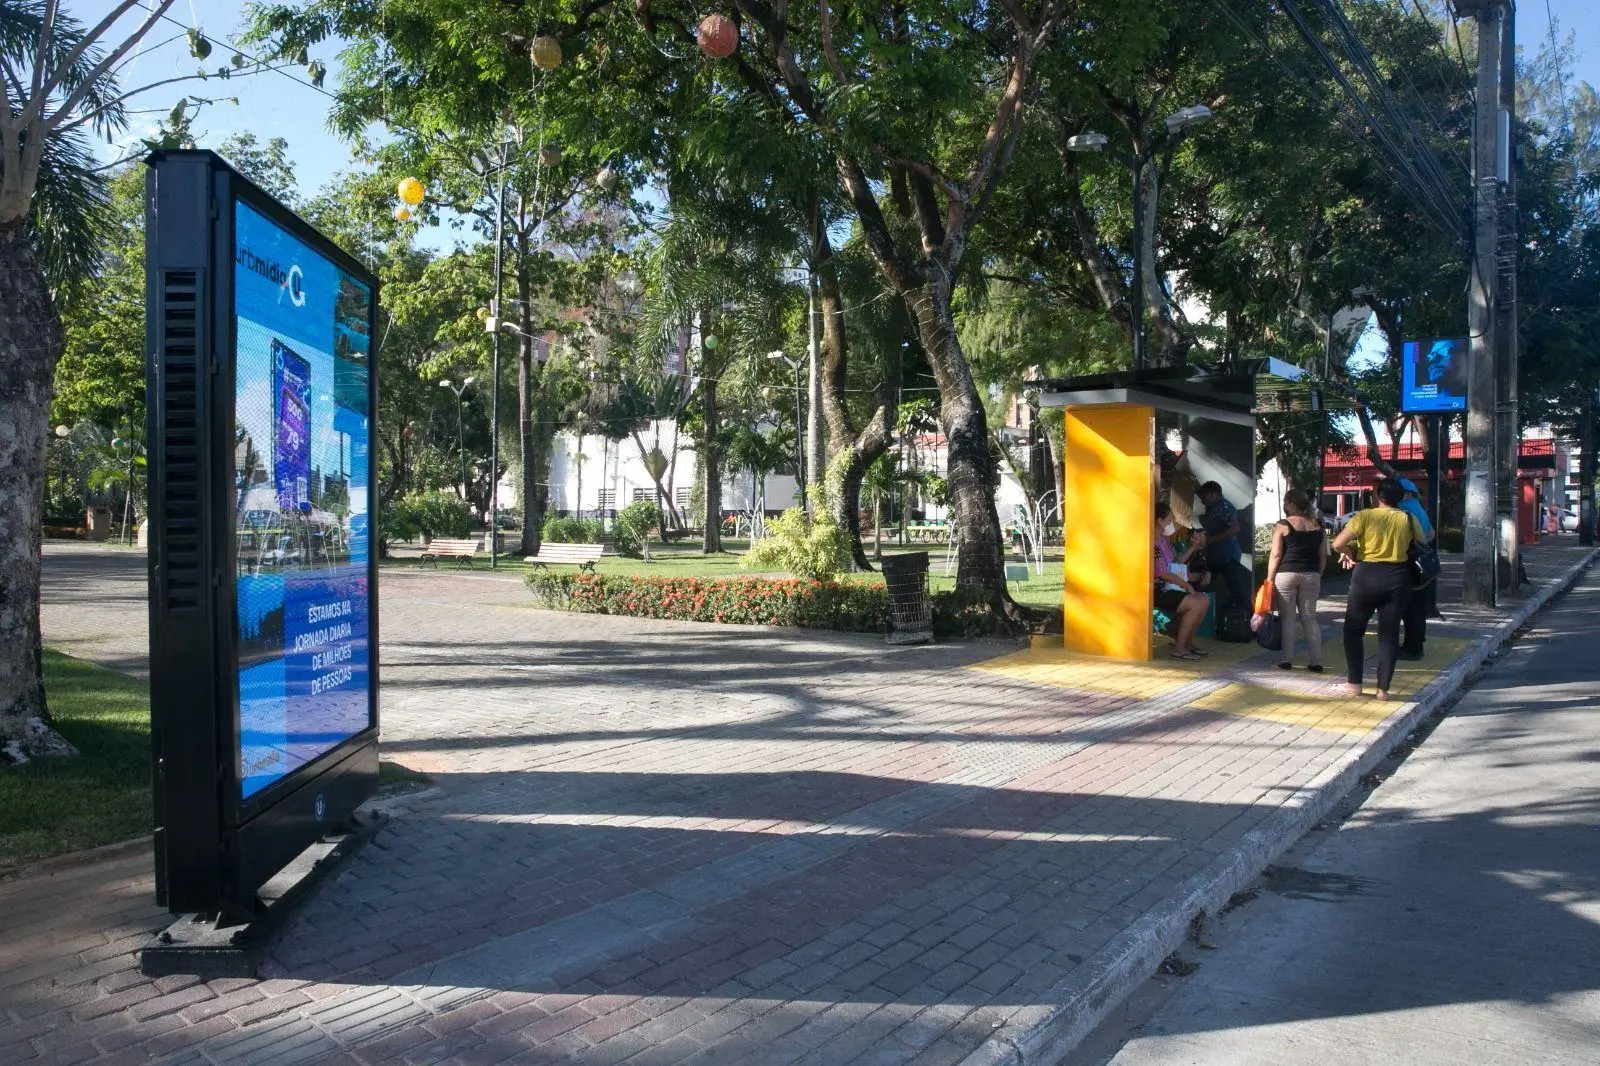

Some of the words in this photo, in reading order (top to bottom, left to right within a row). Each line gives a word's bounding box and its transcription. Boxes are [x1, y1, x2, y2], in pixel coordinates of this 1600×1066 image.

[308, 603, 341, 624] ESTAMOS
[341, 600, 352, 616] NA
[293, 628, 329, 653] JORNADA
[312, 654, 322, 671] DE
[311, 677, 322, 696] DE
[322, 665, 352, 692] PESSOAS
